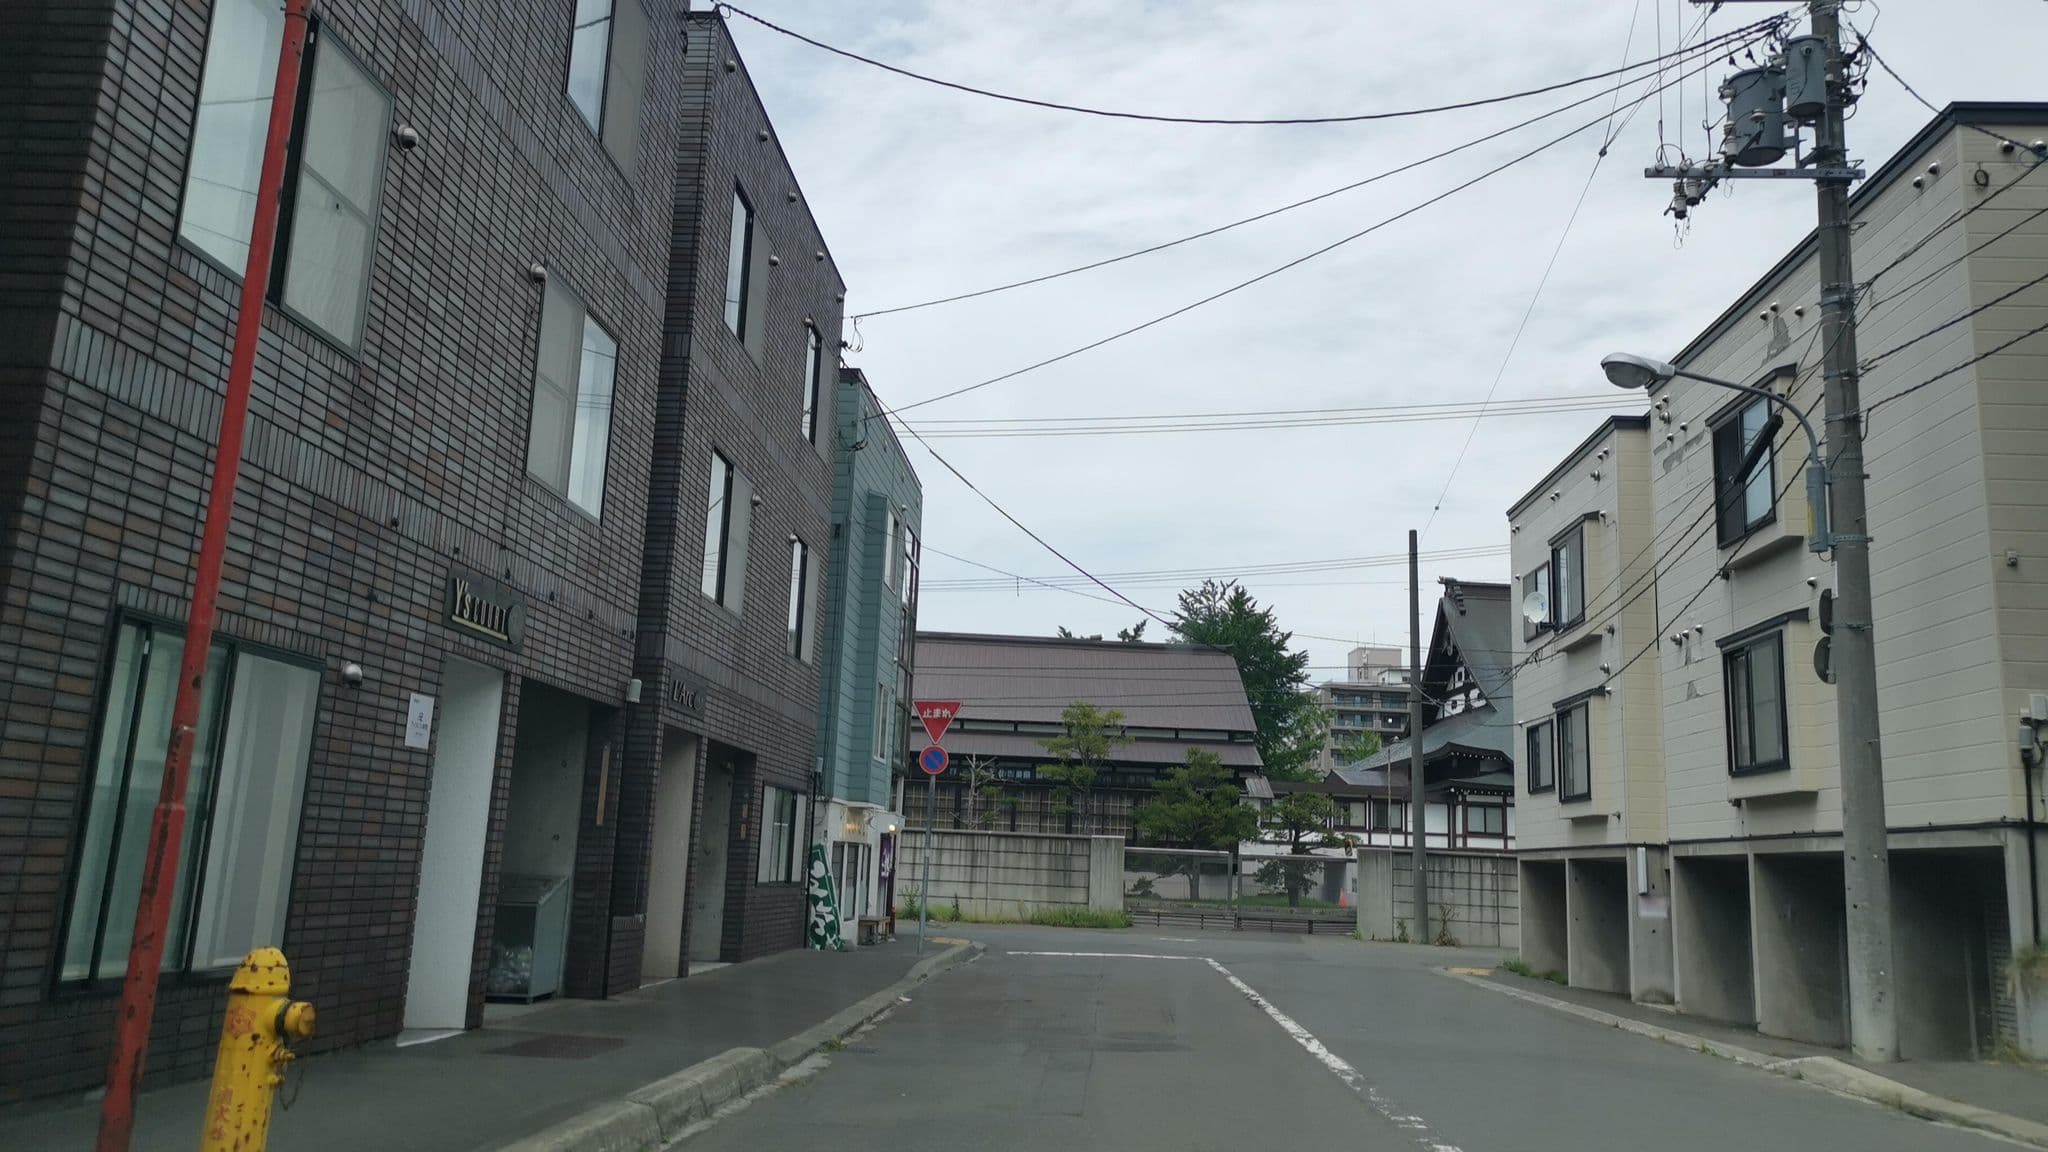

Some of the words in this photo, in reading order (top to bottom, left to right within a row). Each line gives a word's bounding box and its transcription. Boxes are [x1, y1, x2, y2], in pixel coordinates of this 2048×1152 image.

[456, 577, 472, 619] Y's
[922, 707, 951, 719] 止まれ
